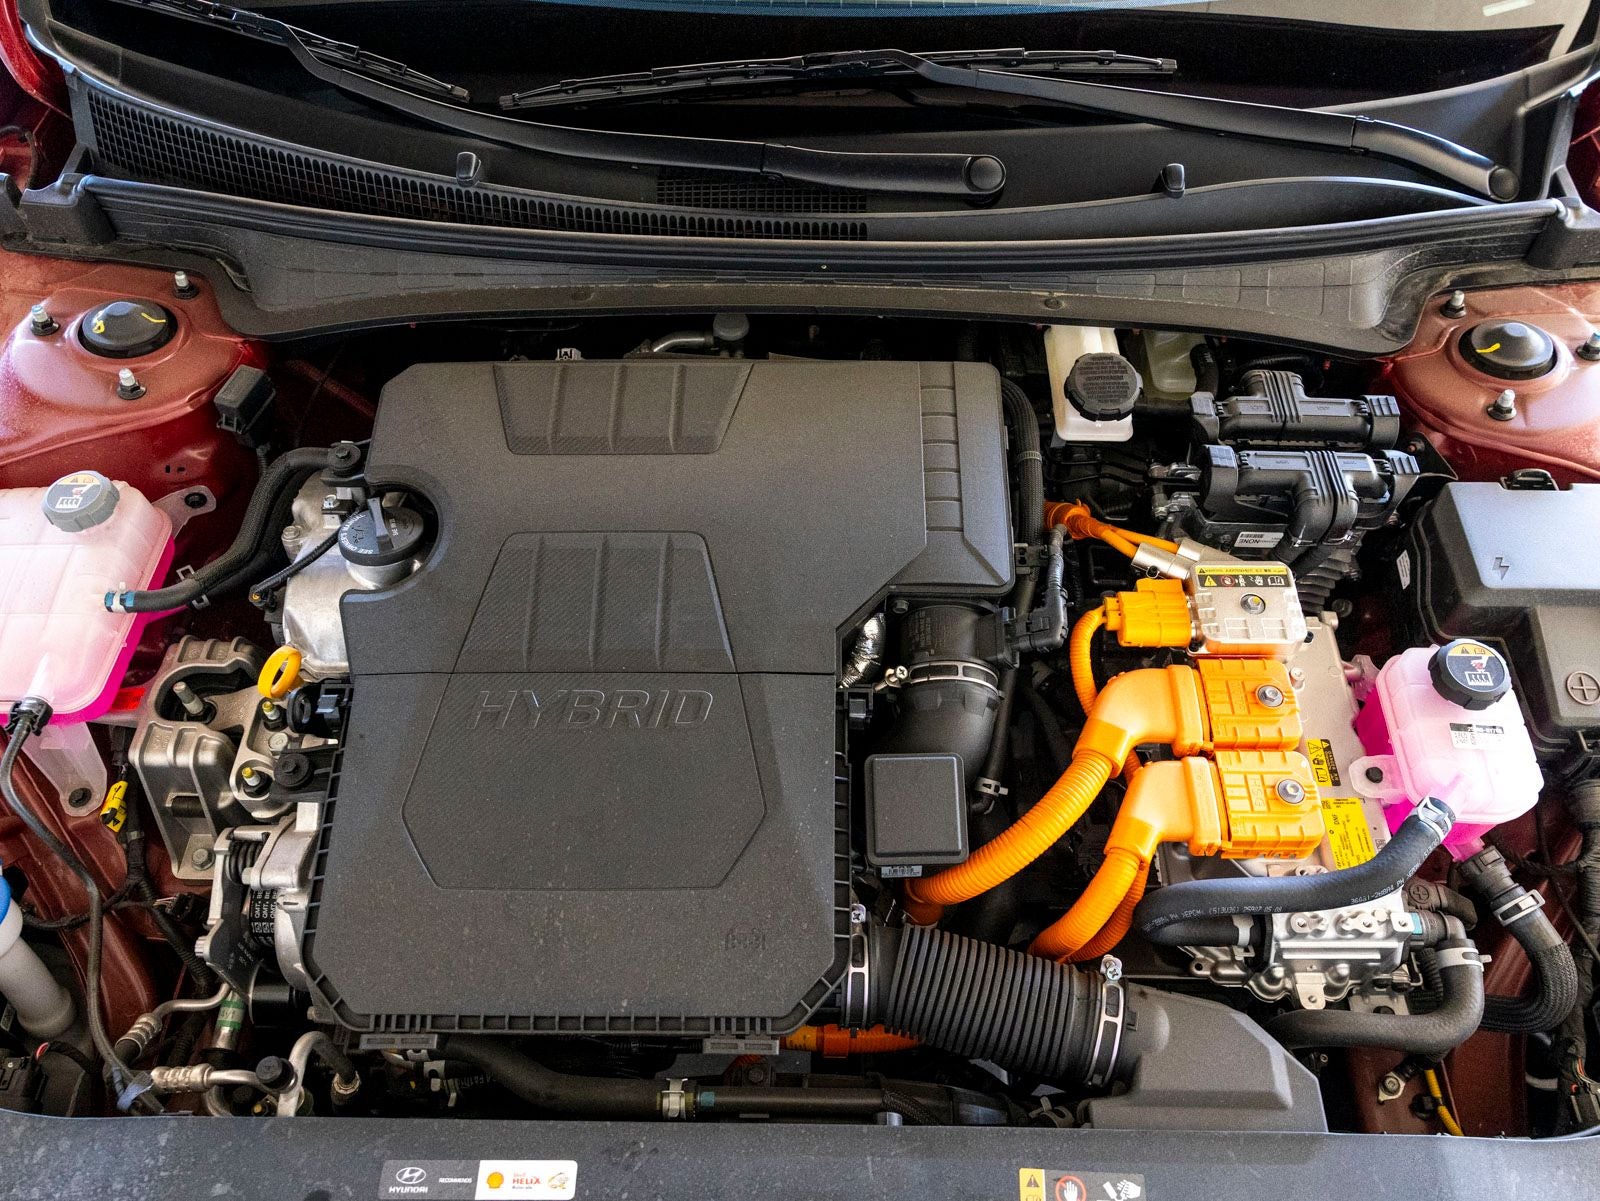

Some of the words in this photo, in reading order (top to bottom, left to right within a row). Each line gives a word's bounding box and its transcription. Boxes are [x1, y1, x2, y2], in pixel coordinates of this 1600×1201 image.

[466, 689, 714, 729] HYBRID
[512, 1177, 541, 1185] HELIX
[388, 1185, 429, 1194] HYUNDAI
